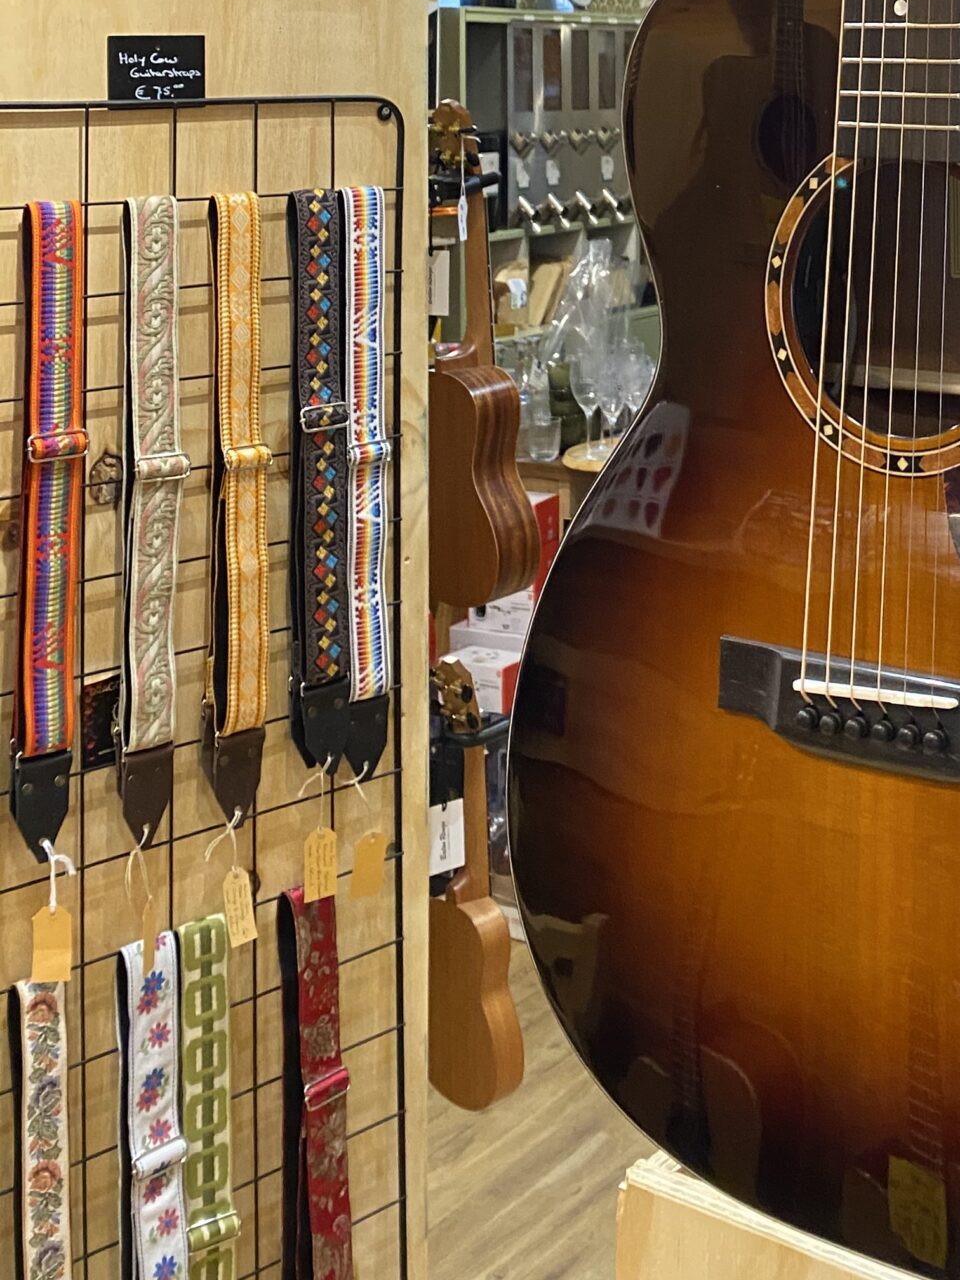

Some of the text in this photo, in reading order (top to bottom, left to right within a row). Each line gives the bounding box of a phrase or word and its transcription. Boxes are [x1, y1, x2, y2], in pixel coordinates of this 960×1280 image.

[119, 52, 178, 66] Holy Cow
[129, 67, 202, 79] Guitarstraps
